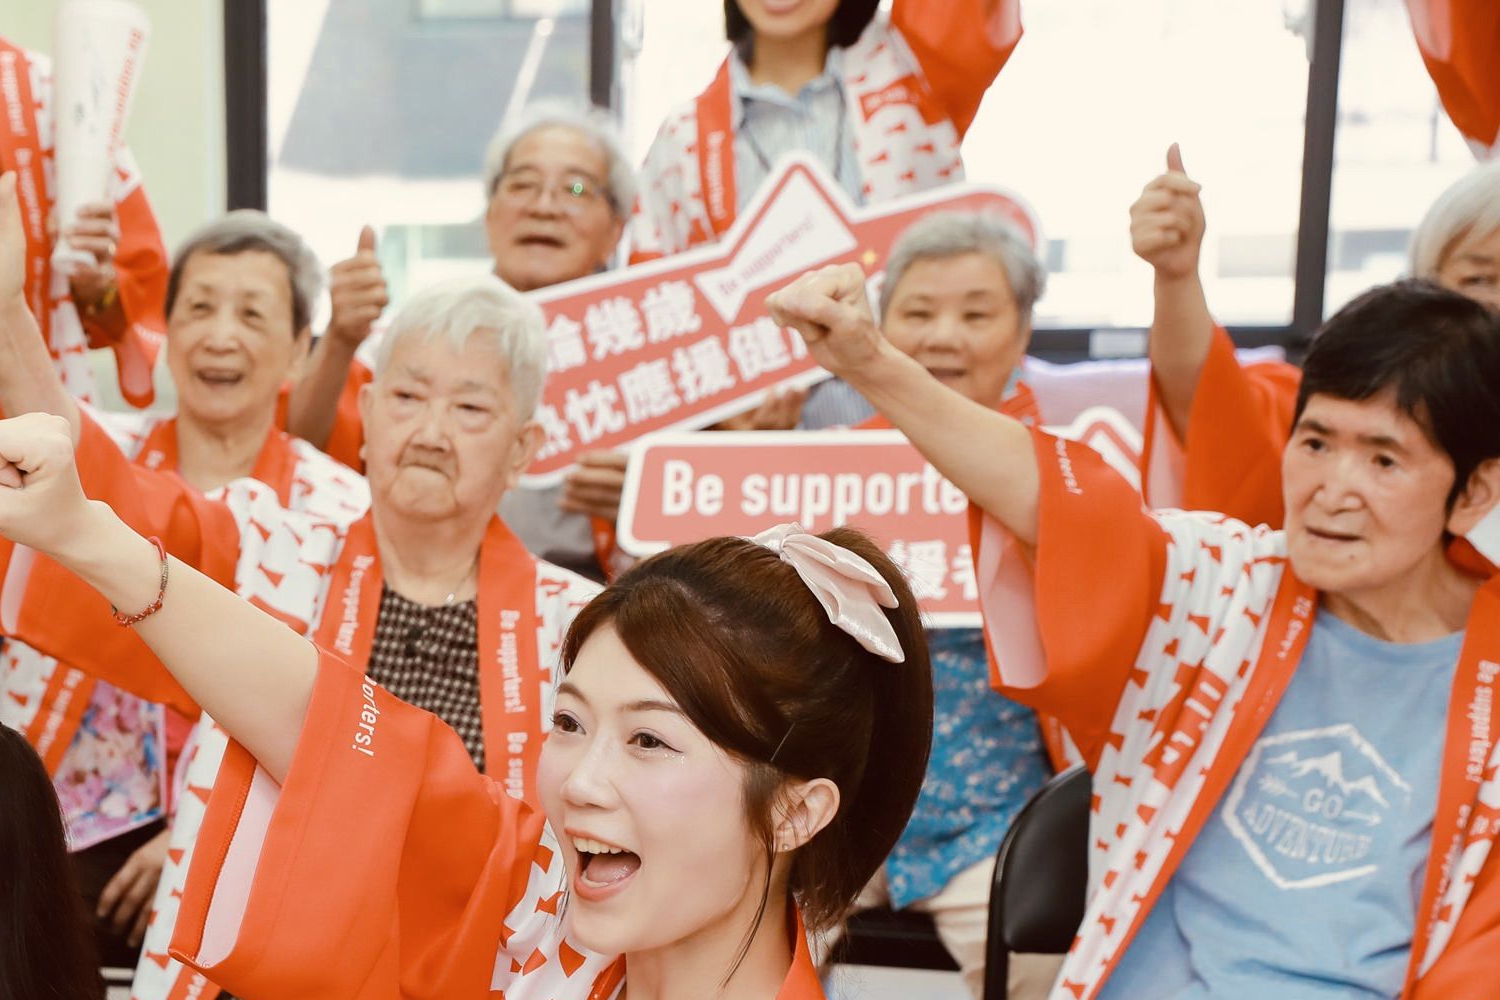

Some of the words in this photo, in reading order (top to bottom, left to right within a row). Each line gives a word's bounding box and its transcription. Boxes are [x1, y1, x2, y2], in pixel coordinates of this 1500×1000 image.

[660, 460, 725, 517] Be
[496, 631, 527, 714] supporters!
[1303, 787, 1344, 820] GO
